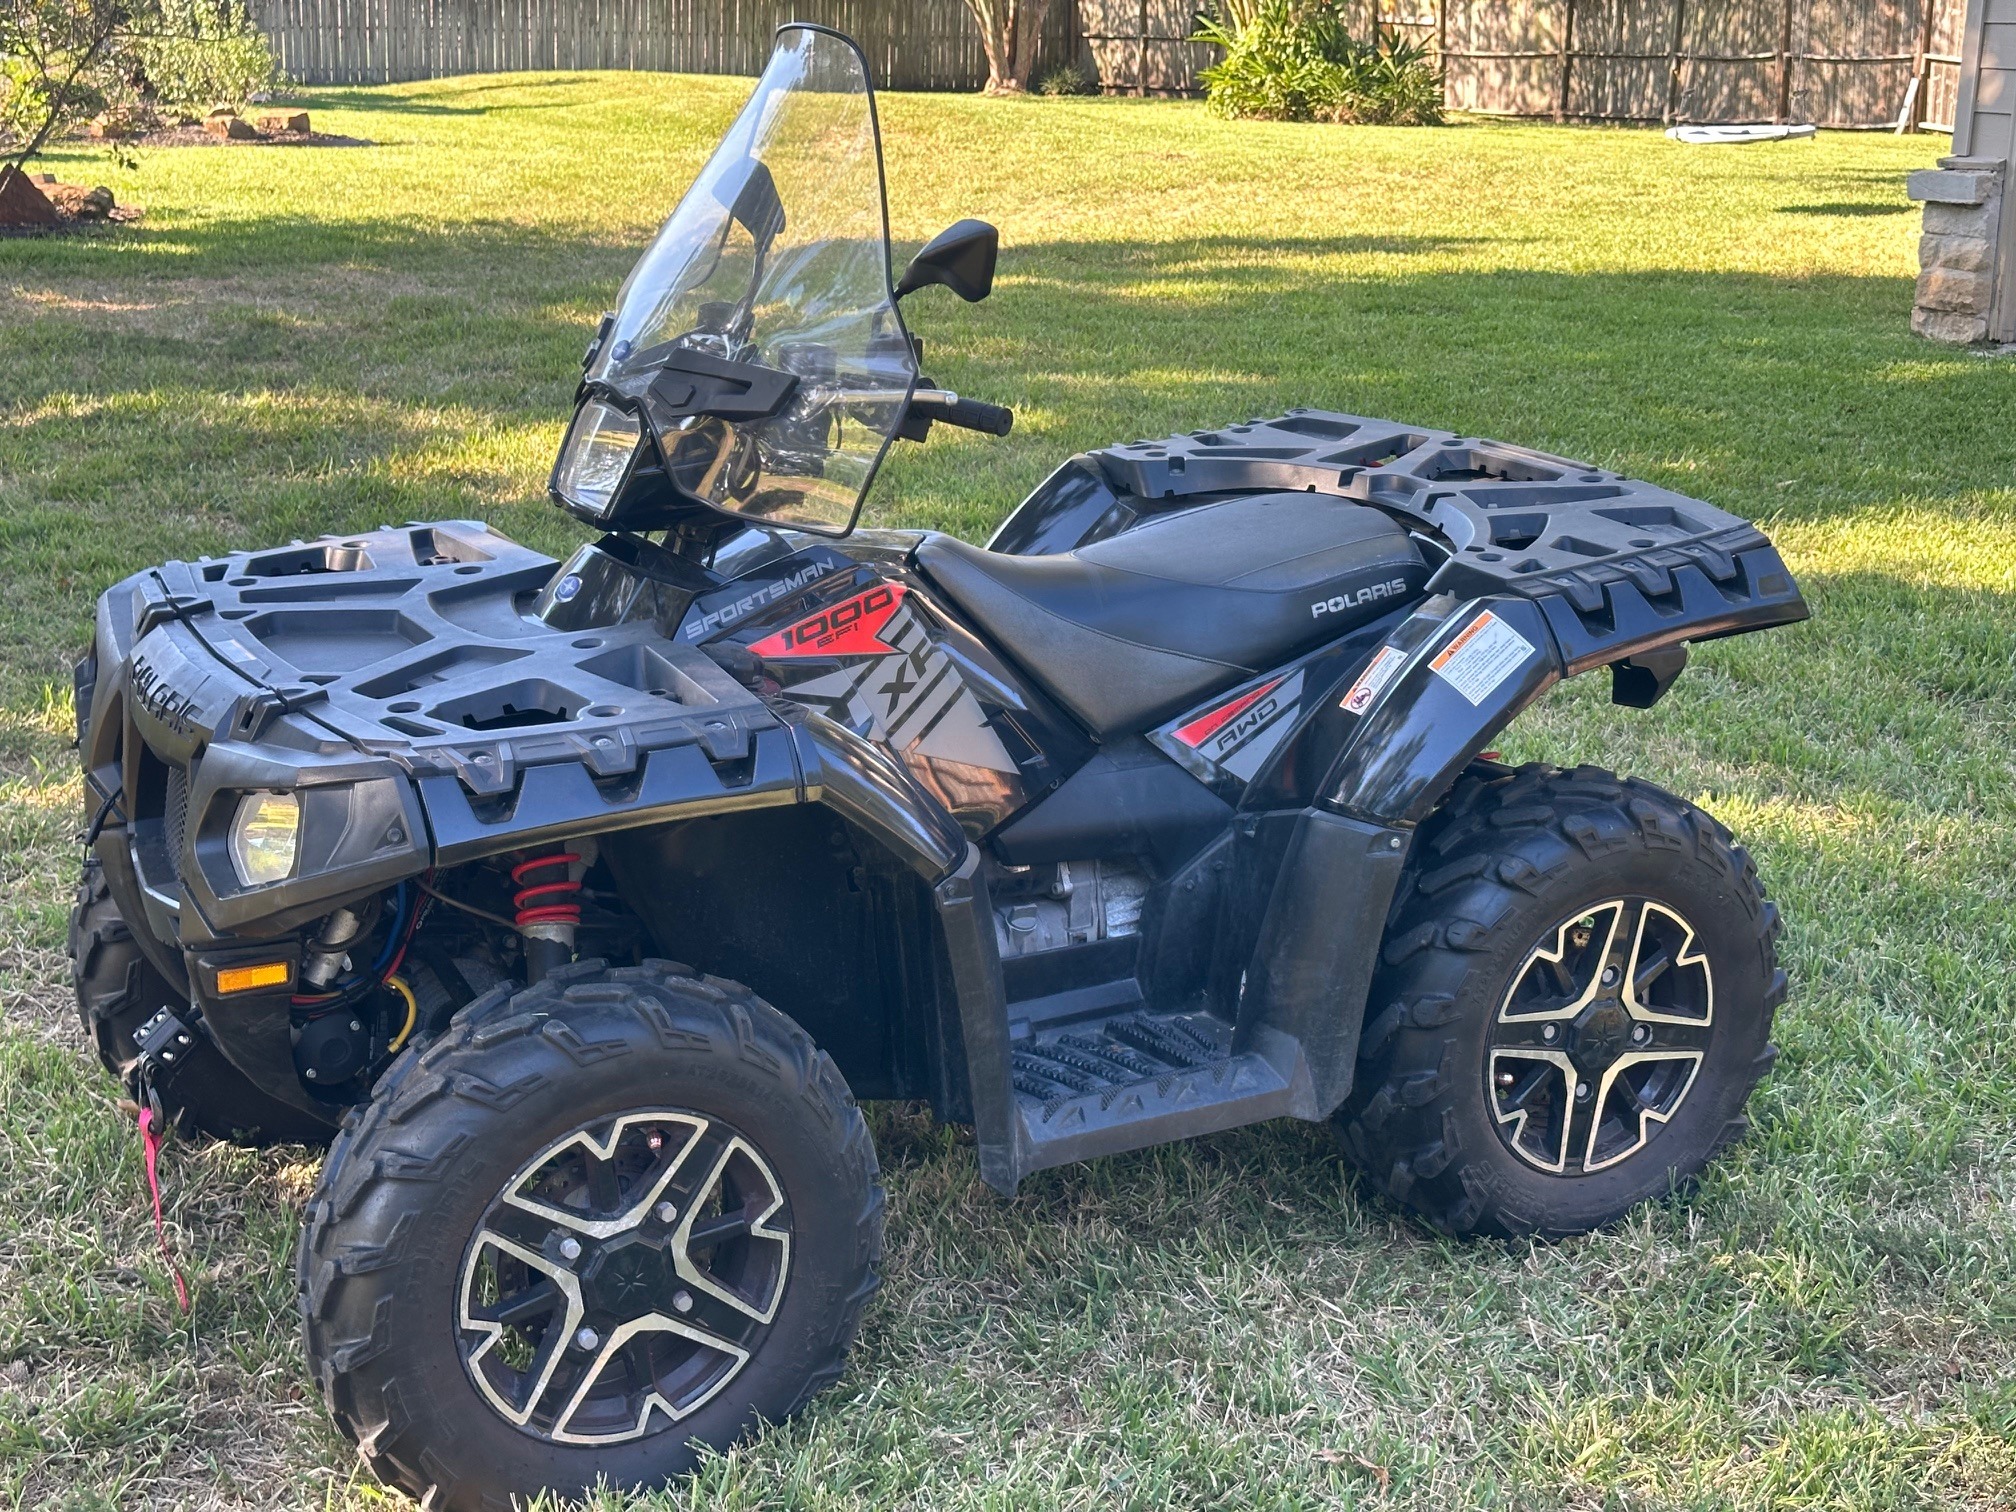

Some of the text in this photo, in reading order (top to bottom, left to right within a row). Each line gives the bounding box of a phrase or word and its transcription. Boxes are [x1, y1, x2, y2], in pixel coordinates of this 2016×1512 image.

[686, 557, 834, 640] SPORTSMAN
[783, 587, 894, 650] 1000
[1311, 578, 1407, 619] POLARIS
[816, 623, 860, 649] EFI
[1451, 625, 1479, 651] WARNING
[1216, 698, 1278, 751] AWD
